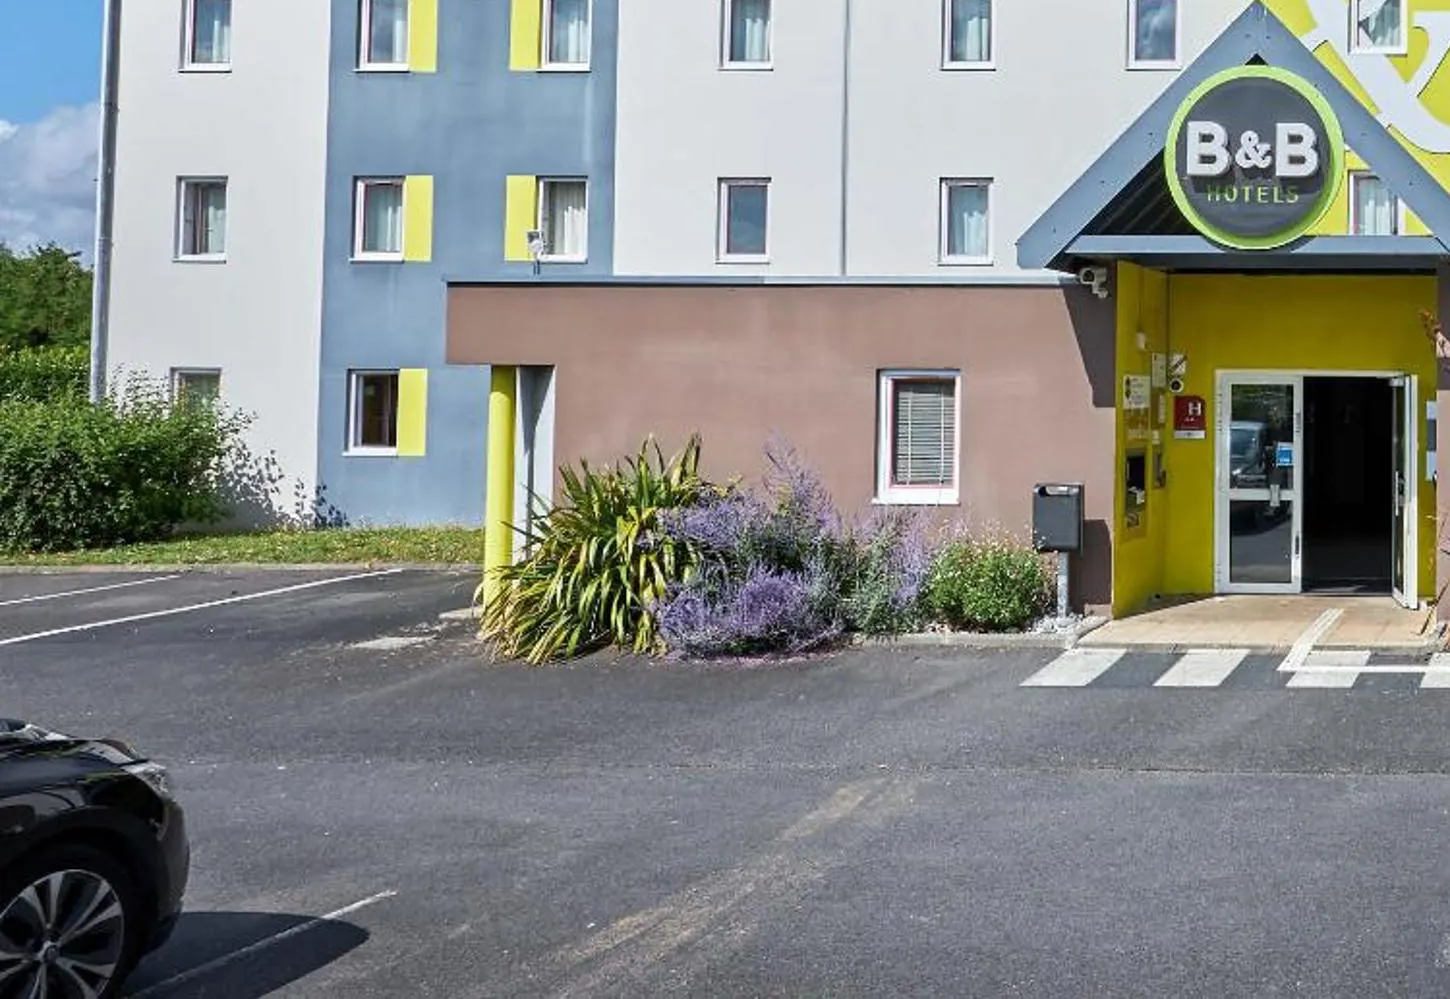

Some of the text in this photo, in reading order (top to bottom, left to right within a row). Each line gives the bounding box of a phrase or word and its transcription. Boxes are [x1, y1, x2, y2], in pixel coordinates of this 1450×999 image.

[1186, 121, 1318, 176] B&B
[1207, 185, 1299, 203] HOTELS
[1188, 402, 1202, 416] H
